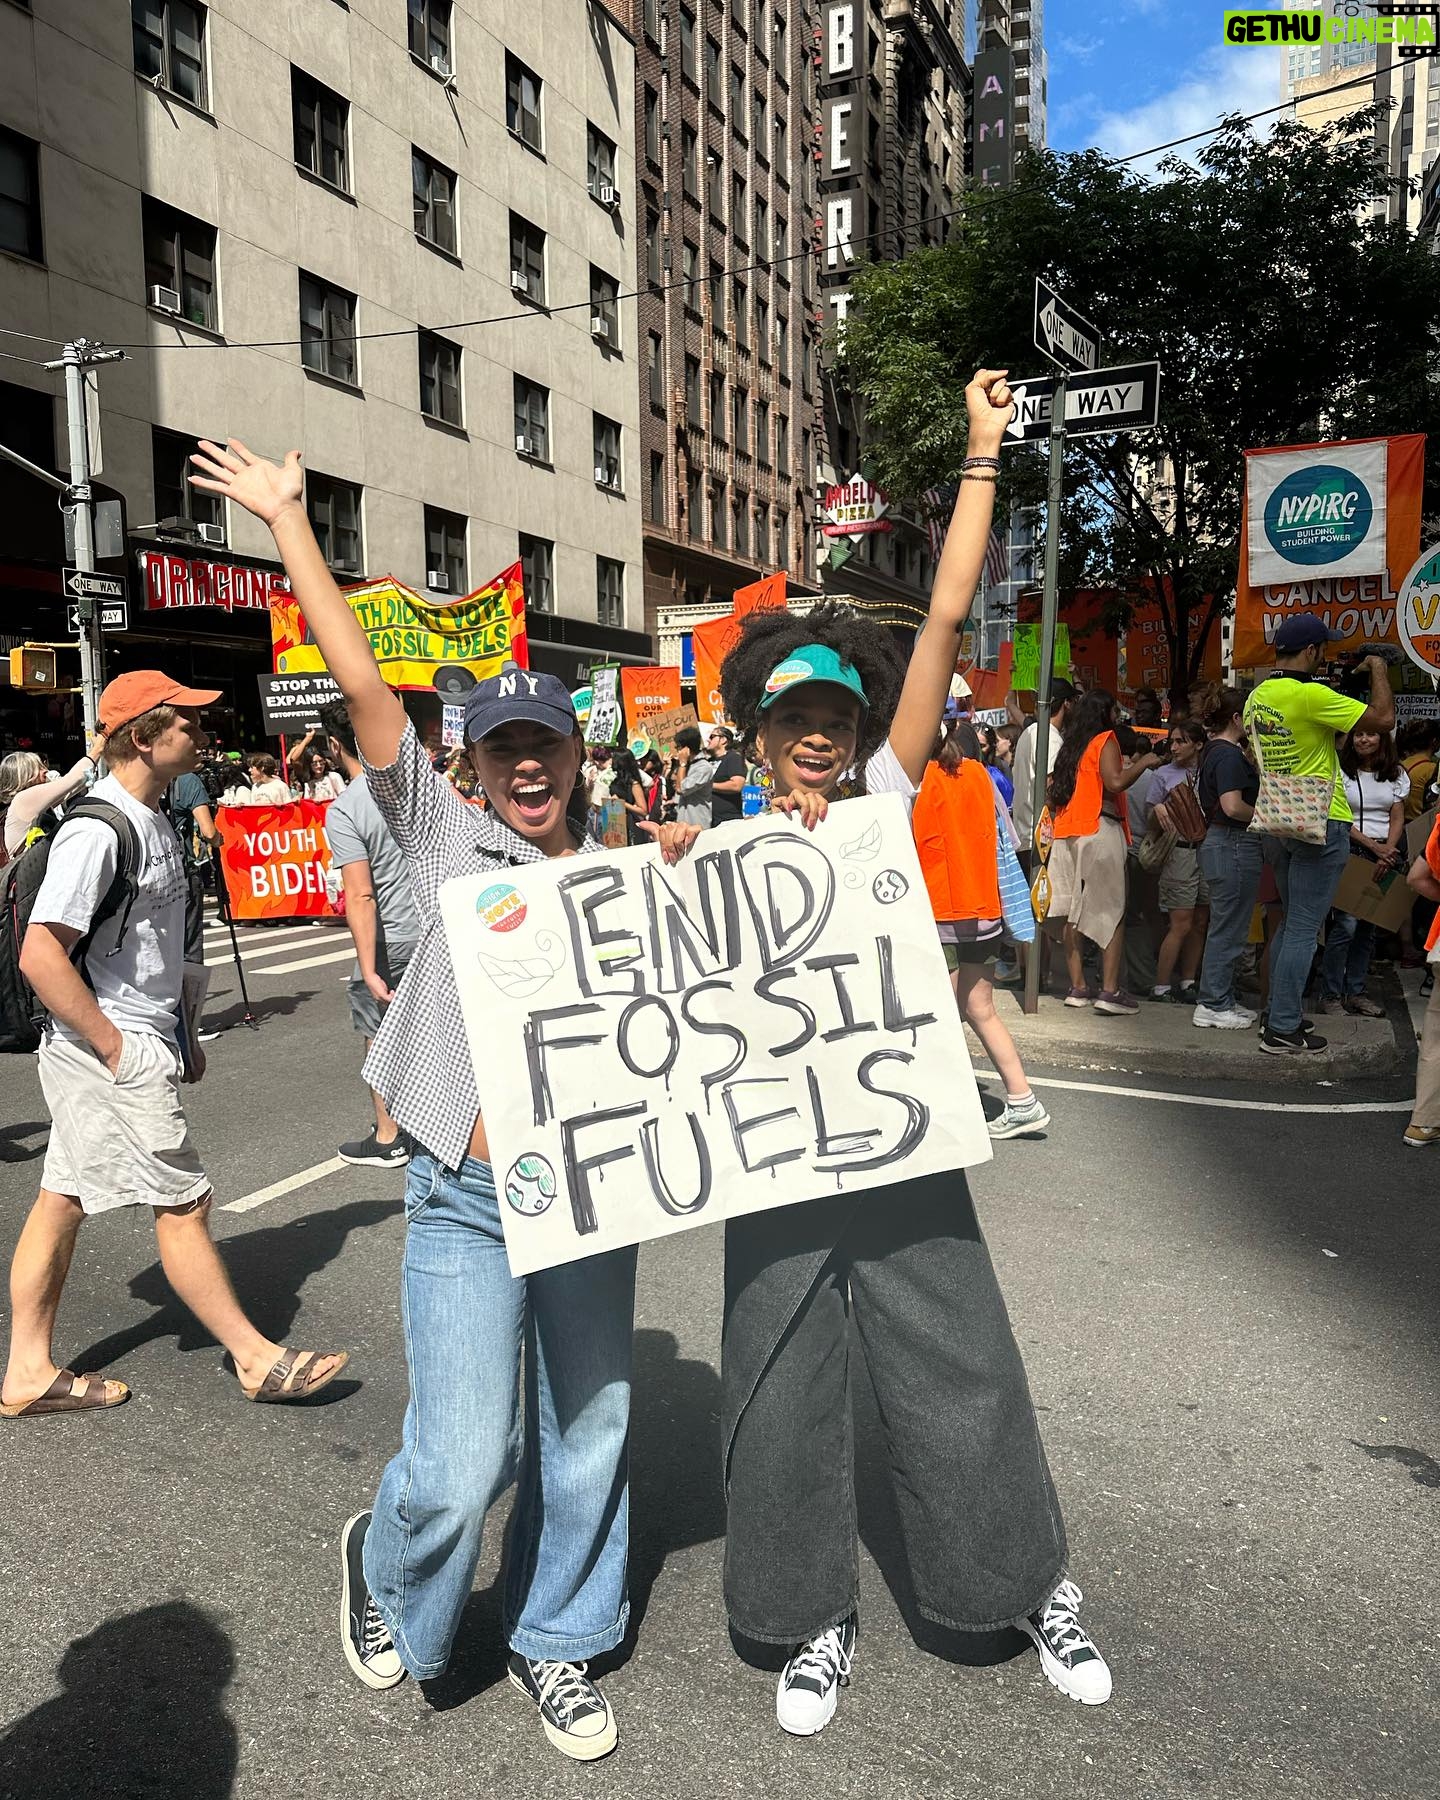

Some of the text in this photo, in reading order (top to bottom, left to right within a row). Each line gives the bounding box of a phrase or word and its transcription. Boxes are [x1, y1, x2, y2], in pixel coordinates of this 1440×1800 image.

[1046, 310, 1092, 366] ONE WAY
[1078, 386, 1132, 415] WAY
[836, 505, 876, 522] PIZZA
[1277, 491, 1359, 527] NYPIRG
[1281, 534, 1351, 548] STUDENT POWER
[1296, 527, 1336, 538] BUILDING
[74, 578, 119, 594] ONE WAY
[1263, 568, 1399, 608] CANCEL
[449, 592, 506, 630] VOTE
[1263, 607, 1396, 645] WLOW
[370, 623, 508, 659] FOSSIL FUELS
[270, 679, 310, 692] STOP
[498, 672, 539, 698] NY
[674, 713, 693, 726] our
[243, 828, 317, 857] YOUTH
[558, 831, 836, 998] END
[524, 934, 938, 1128] FOSSIL
[561, 1049, 930, 1236] FUELS
